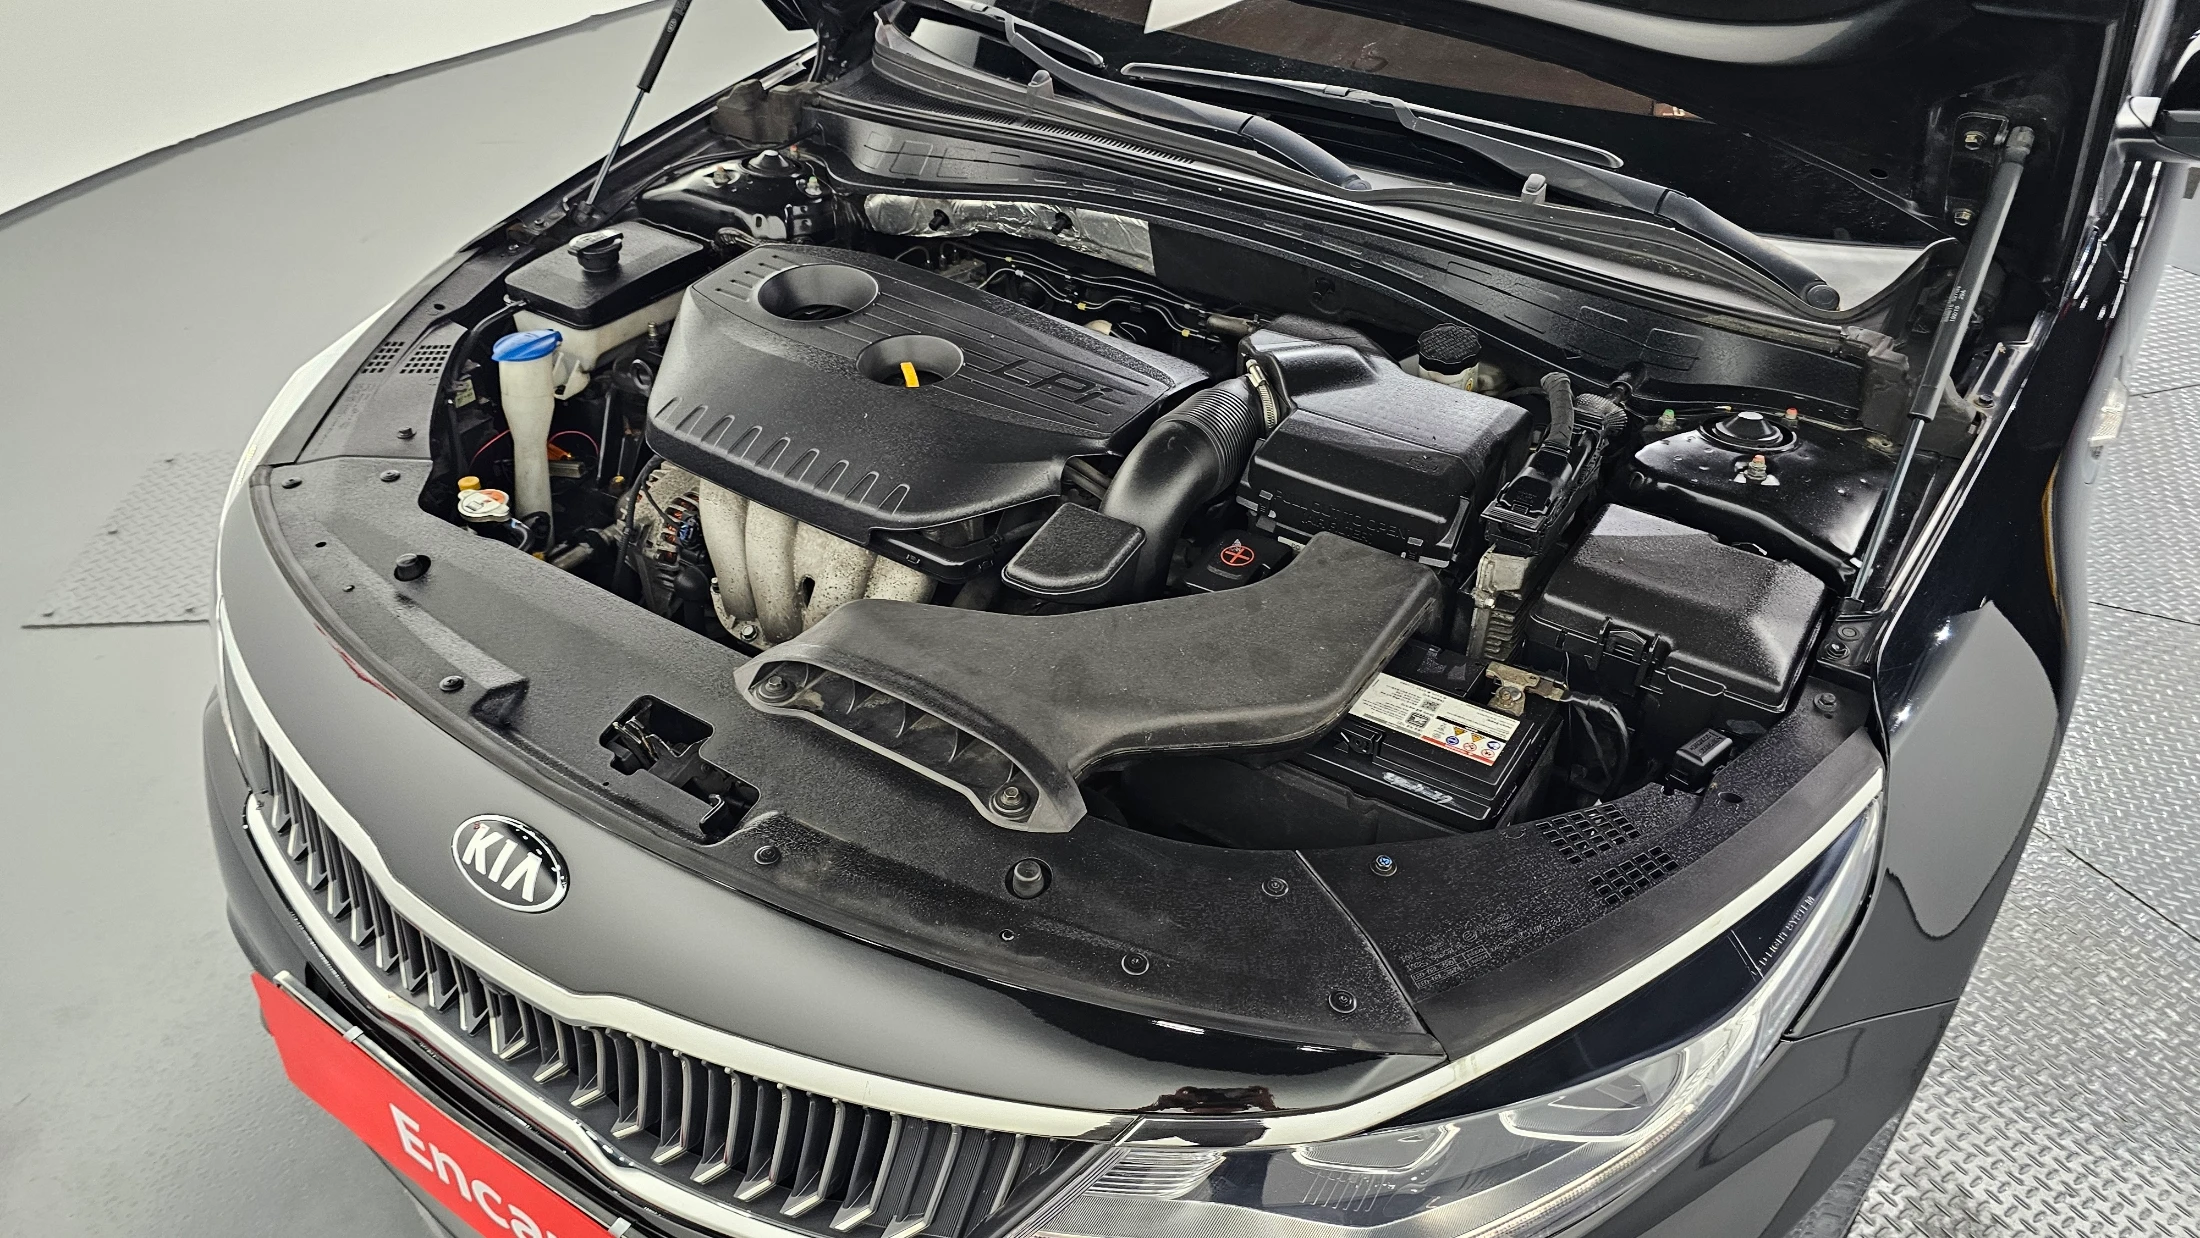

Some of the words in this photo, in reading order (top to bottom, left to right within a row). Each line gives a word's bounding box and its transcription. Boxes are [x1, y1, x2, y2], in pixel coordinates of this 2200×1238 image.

[462, 822, 543, 902] KIA
[1764, 931, 1789, 958] LIGHT
[1784, 895, 1816, 931] SYSTEM
